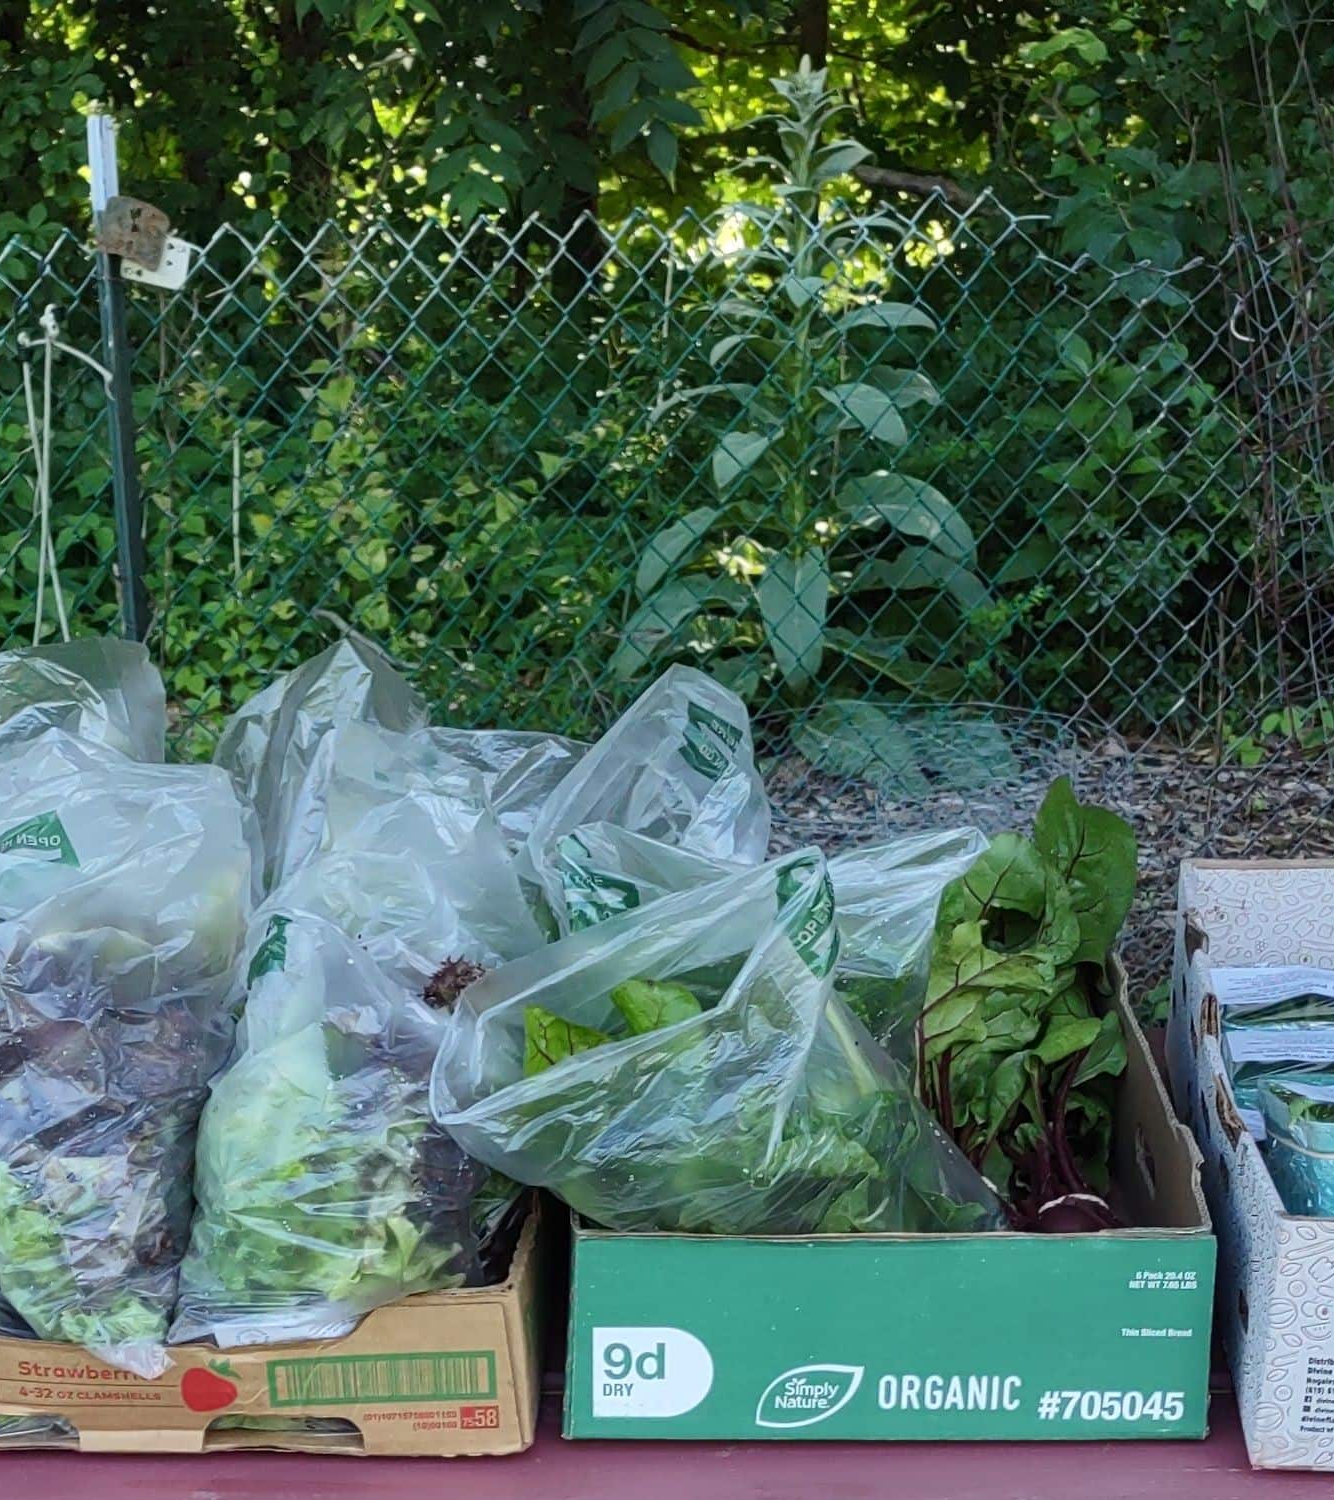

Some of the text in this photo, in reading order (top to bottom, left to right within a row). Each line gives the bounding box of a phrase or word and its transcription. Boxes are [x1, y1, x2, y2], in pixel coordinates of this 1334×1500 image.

[18, 1360, 163, 1381] Strawberr
[602, 1341, 666, 1382] 9d
[1307, 1367, 1333, 1376] Divine
[18, 1386, 161, 1401] 4-32 OZ CLAMSHELLS
[602, 1383, 633, 1398] DRY
[783, 1376, 839, 1400] Simply
[877, 1374, 1022, 1412] ORGANIC
[774, 1394, 832, 1410] Nature
[1037, 1390, 1185, 1422] #705045
